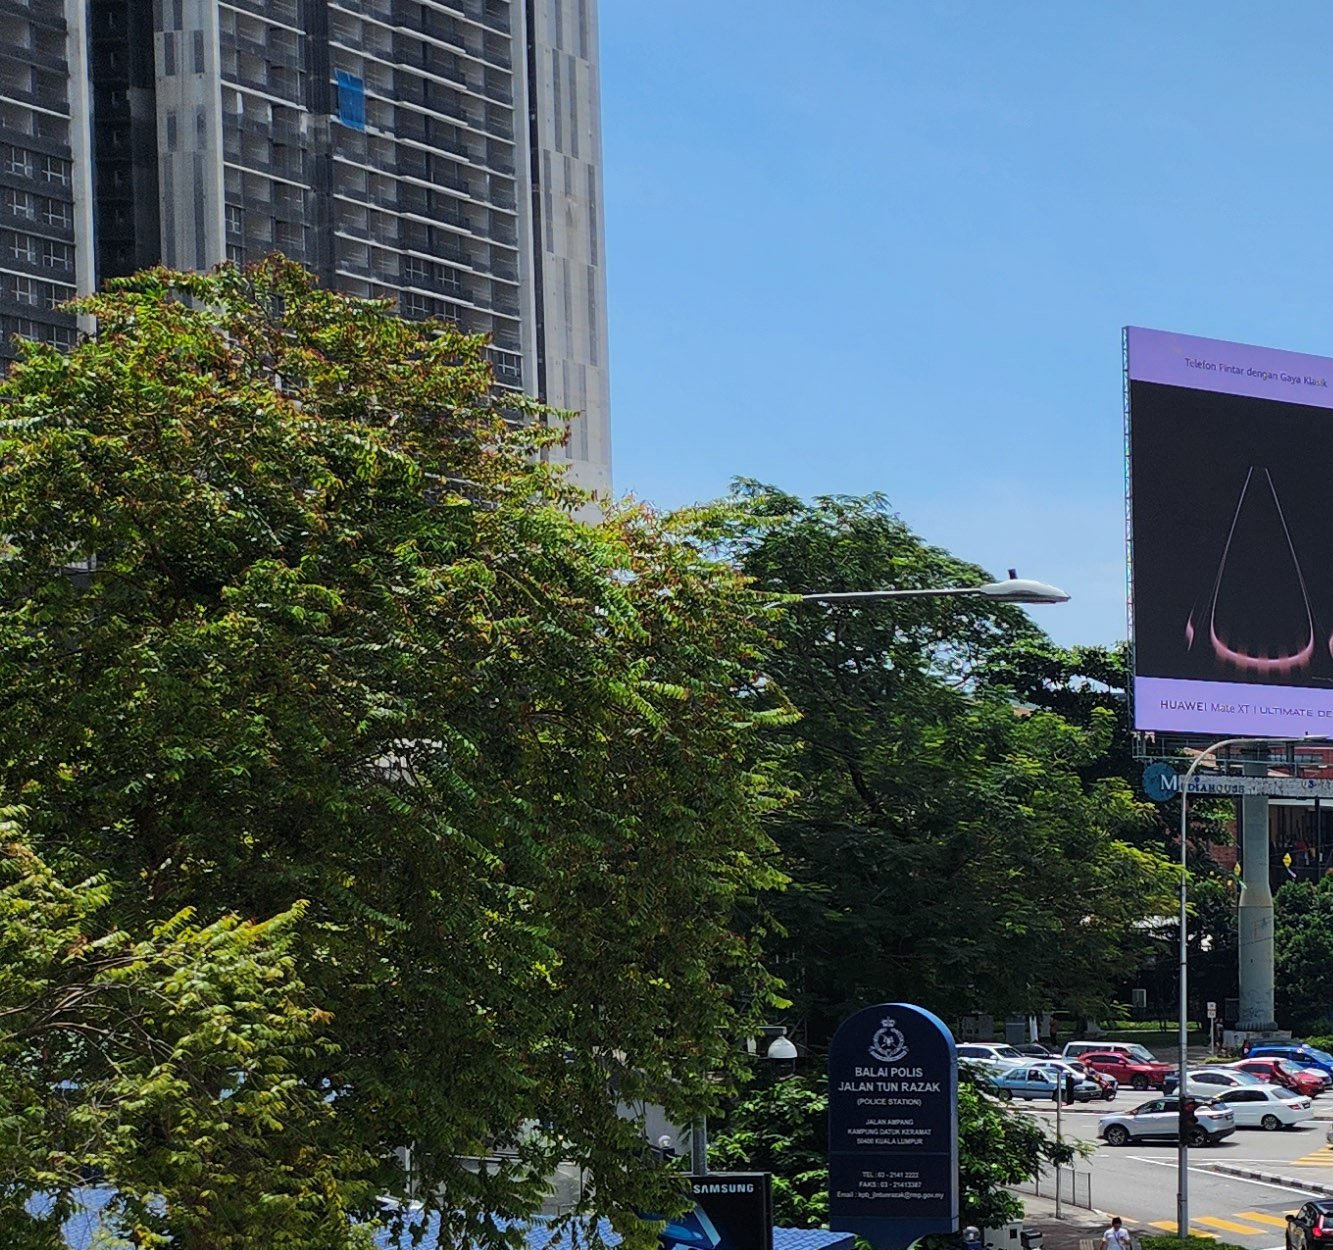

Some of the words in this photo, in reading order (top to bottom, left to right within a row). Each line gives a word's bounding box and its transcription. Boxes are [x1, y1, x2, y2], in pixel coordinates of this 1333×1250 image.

[1184, 358, 1217, 371] Telefon
[1218, 363, 1244, 376] Pintar
[1246, 367, 1278, 381] dengan
[1280, 372, 1301, 384] Gaya
[1160, 700, 1207, 712] HUAWEI
[1210, 703, 1235, 714] Mate
[1237, 704, 1250, 714] XT
[1260, 706, 1313, 717] ULTIMATE
[855, 1067, 888, 1077] BALAI
[890, 1067, 924, 1077] POLIS
[838, 1082, 874, 1092] JALAN
[876, 1082, 898, 1092] TUN
[901, 1082, 940, 1092] RAZAK
[857, 1098, 886, 1106] (POLICE
[888, 1098, 922, 1106] STATION)
[693, 1184, 754, 1194] SAMSUNG
